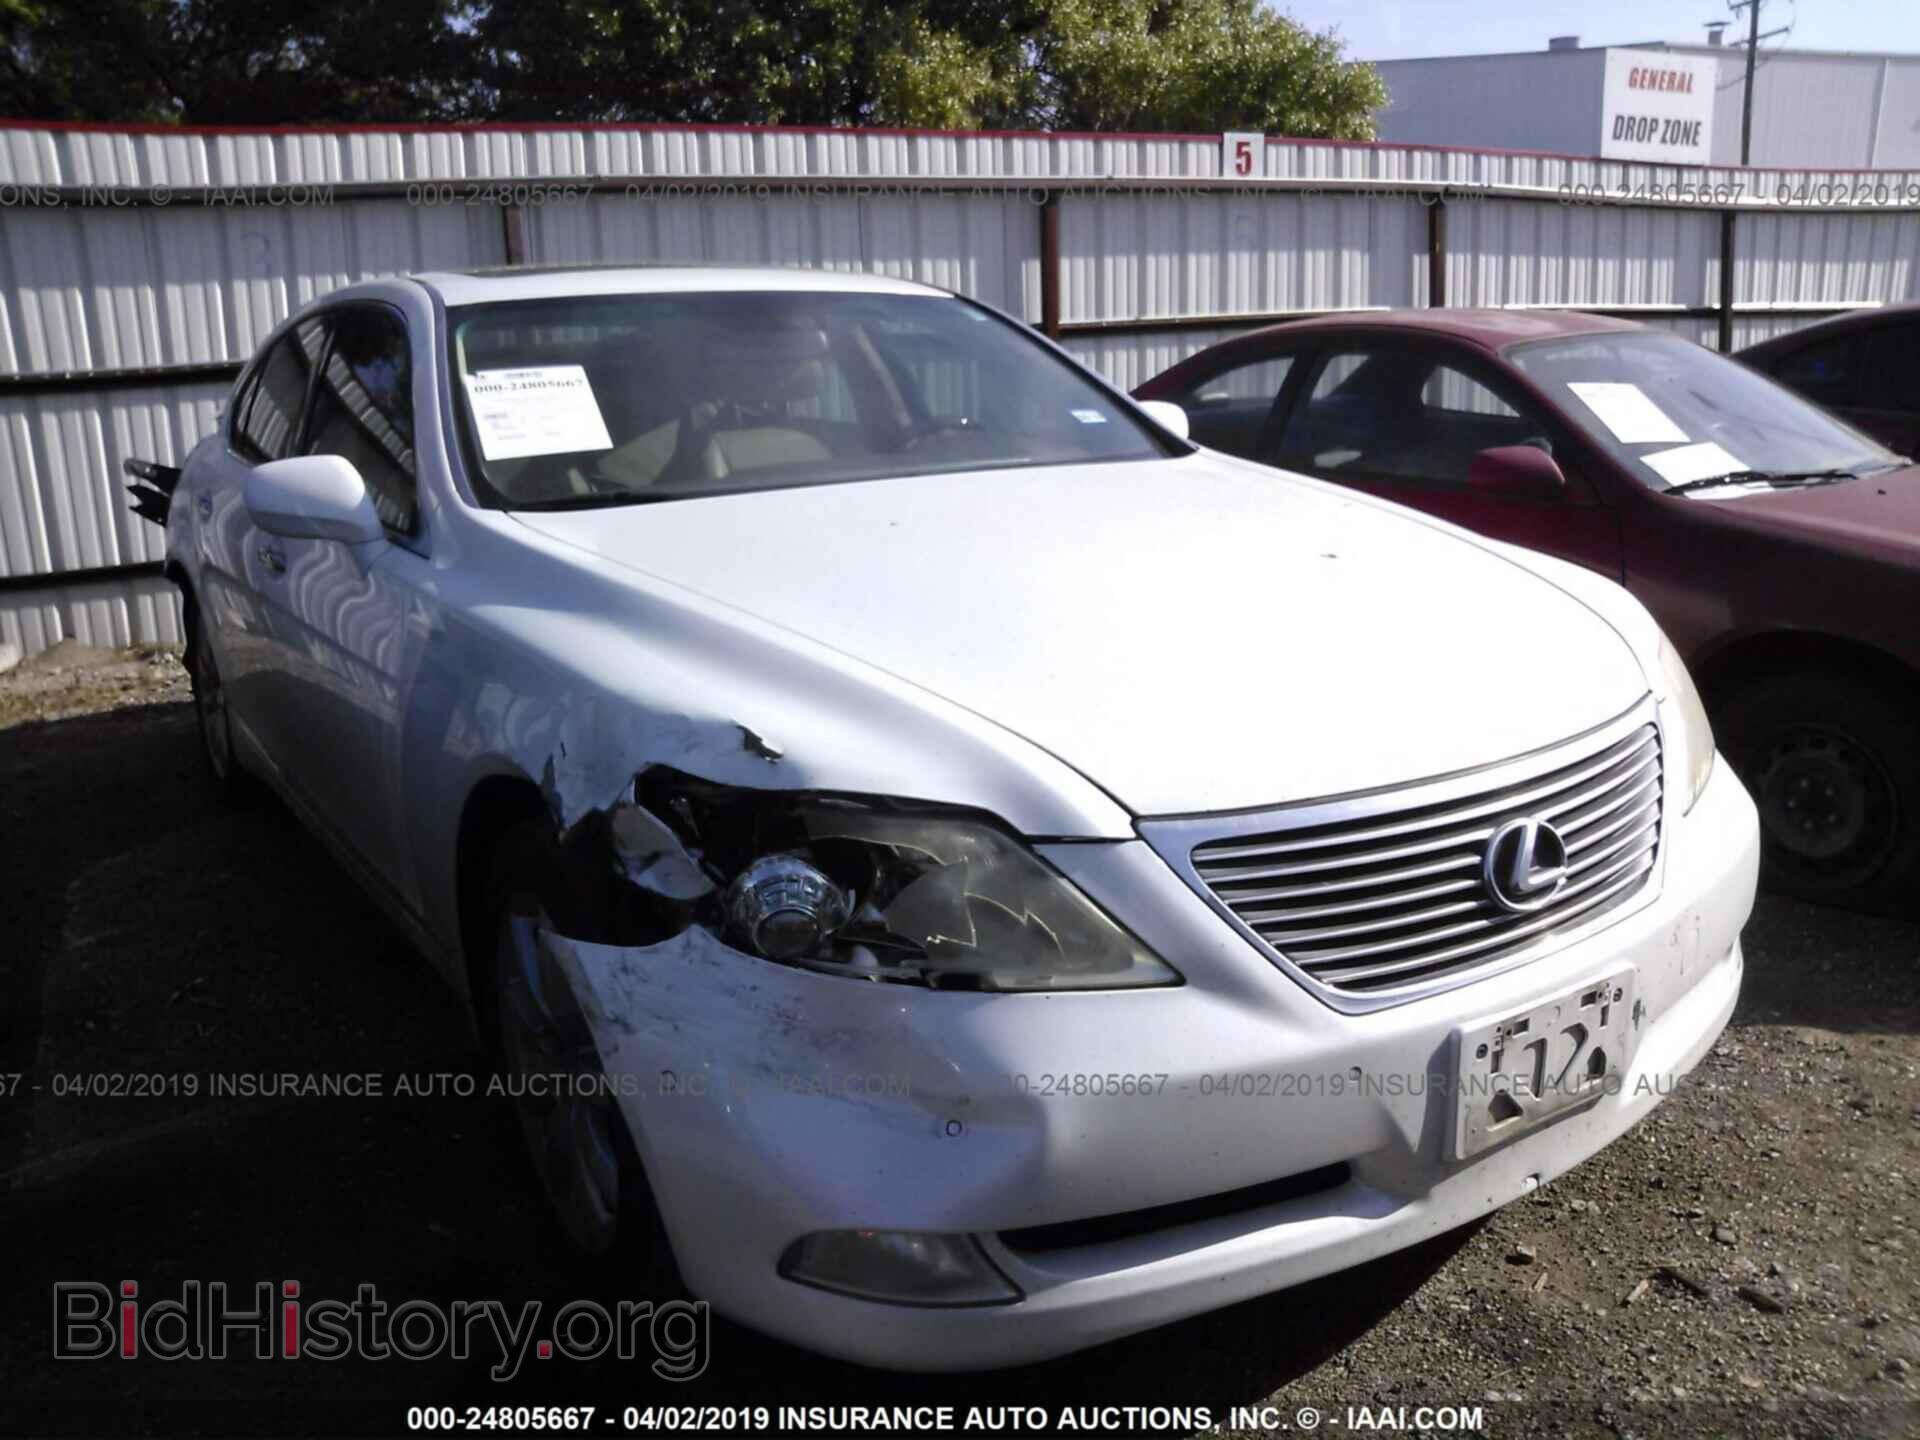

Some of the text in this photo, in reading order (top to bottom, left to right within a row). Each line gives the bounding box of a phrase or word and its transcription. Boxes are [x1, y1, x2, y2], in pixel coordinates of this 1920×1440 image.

[1628, 66, 1694, 94] GENERAL
[1612, 114, 1702, 147] DROP ZONE
[1235, 141, 1252, 176] 5
